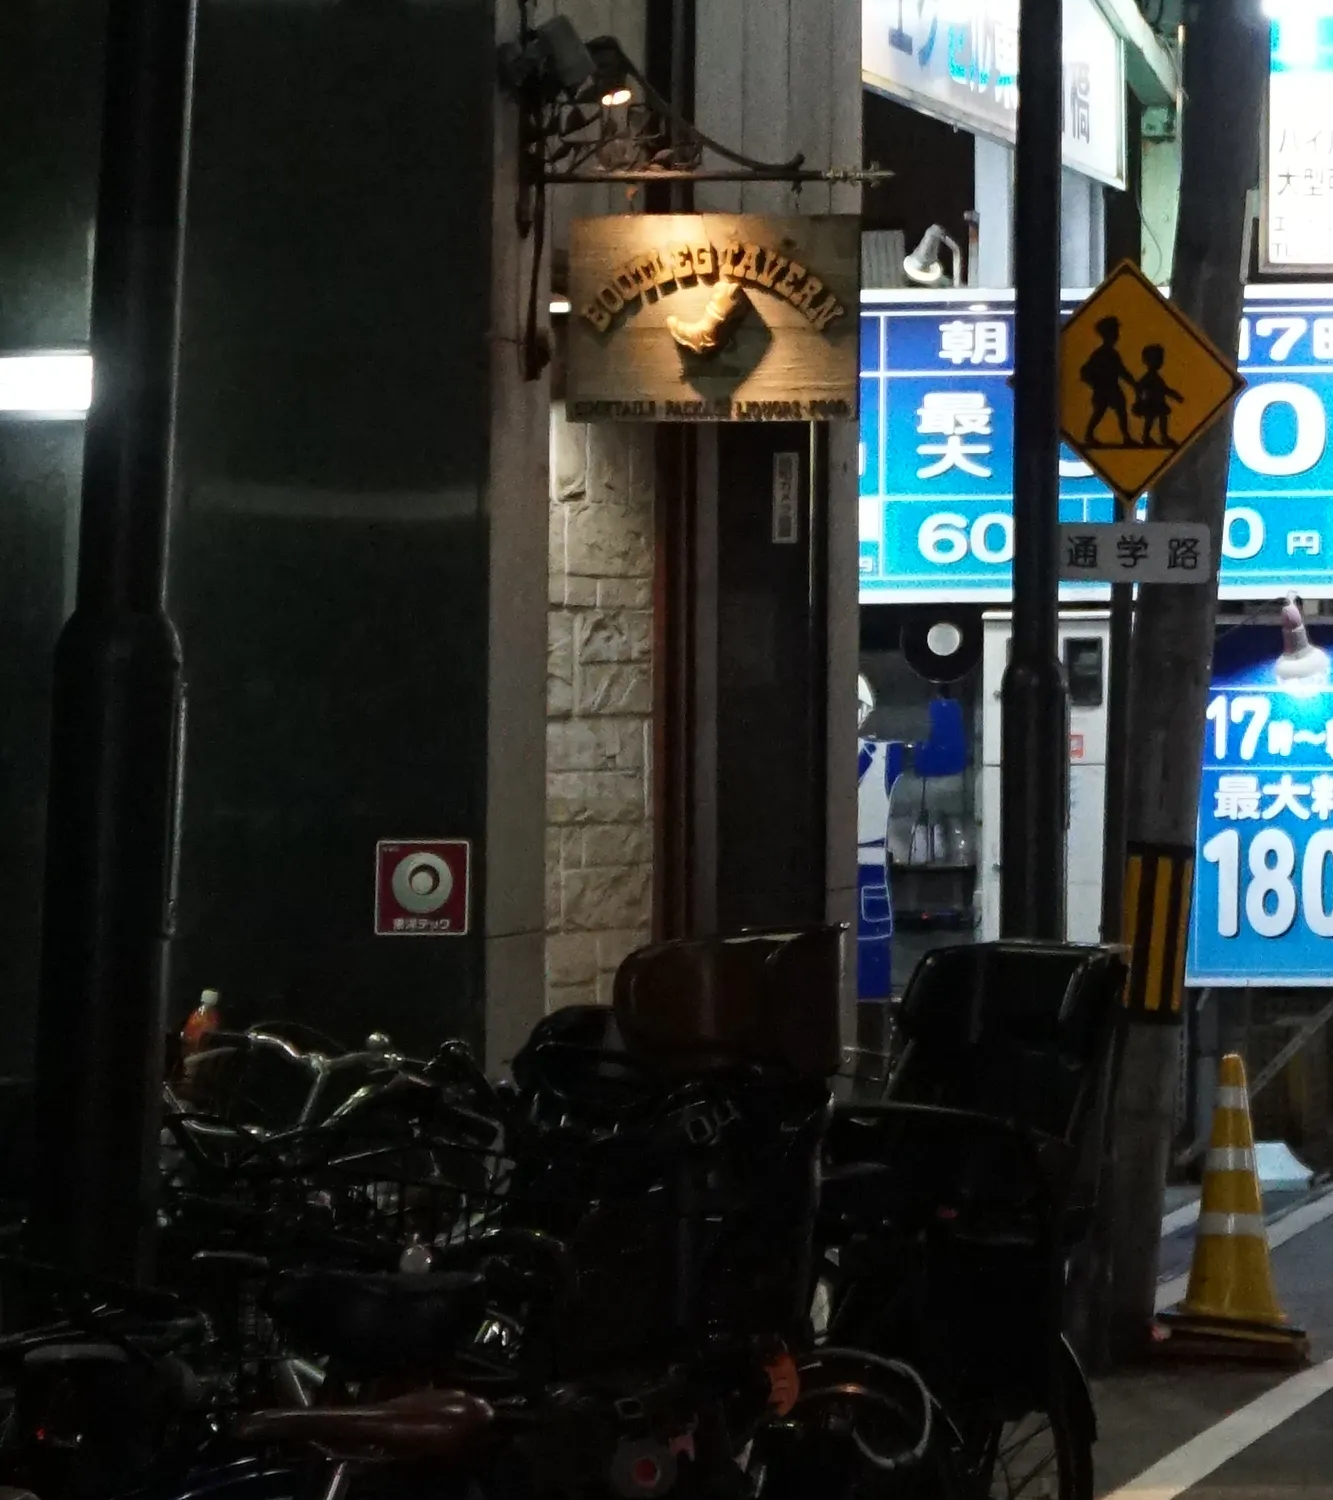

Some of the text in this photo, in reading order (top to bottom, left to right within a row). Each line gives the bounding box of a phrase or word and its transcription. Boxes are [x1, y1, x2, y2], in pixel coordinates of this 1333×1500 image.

[581, 243, 846, 332] BOOTLEG TAVERN
[938, 320, 1008, 364] 朝
[916, 391, 993, 480] 最大
[1066, 534, 1203, 571] 通学路
